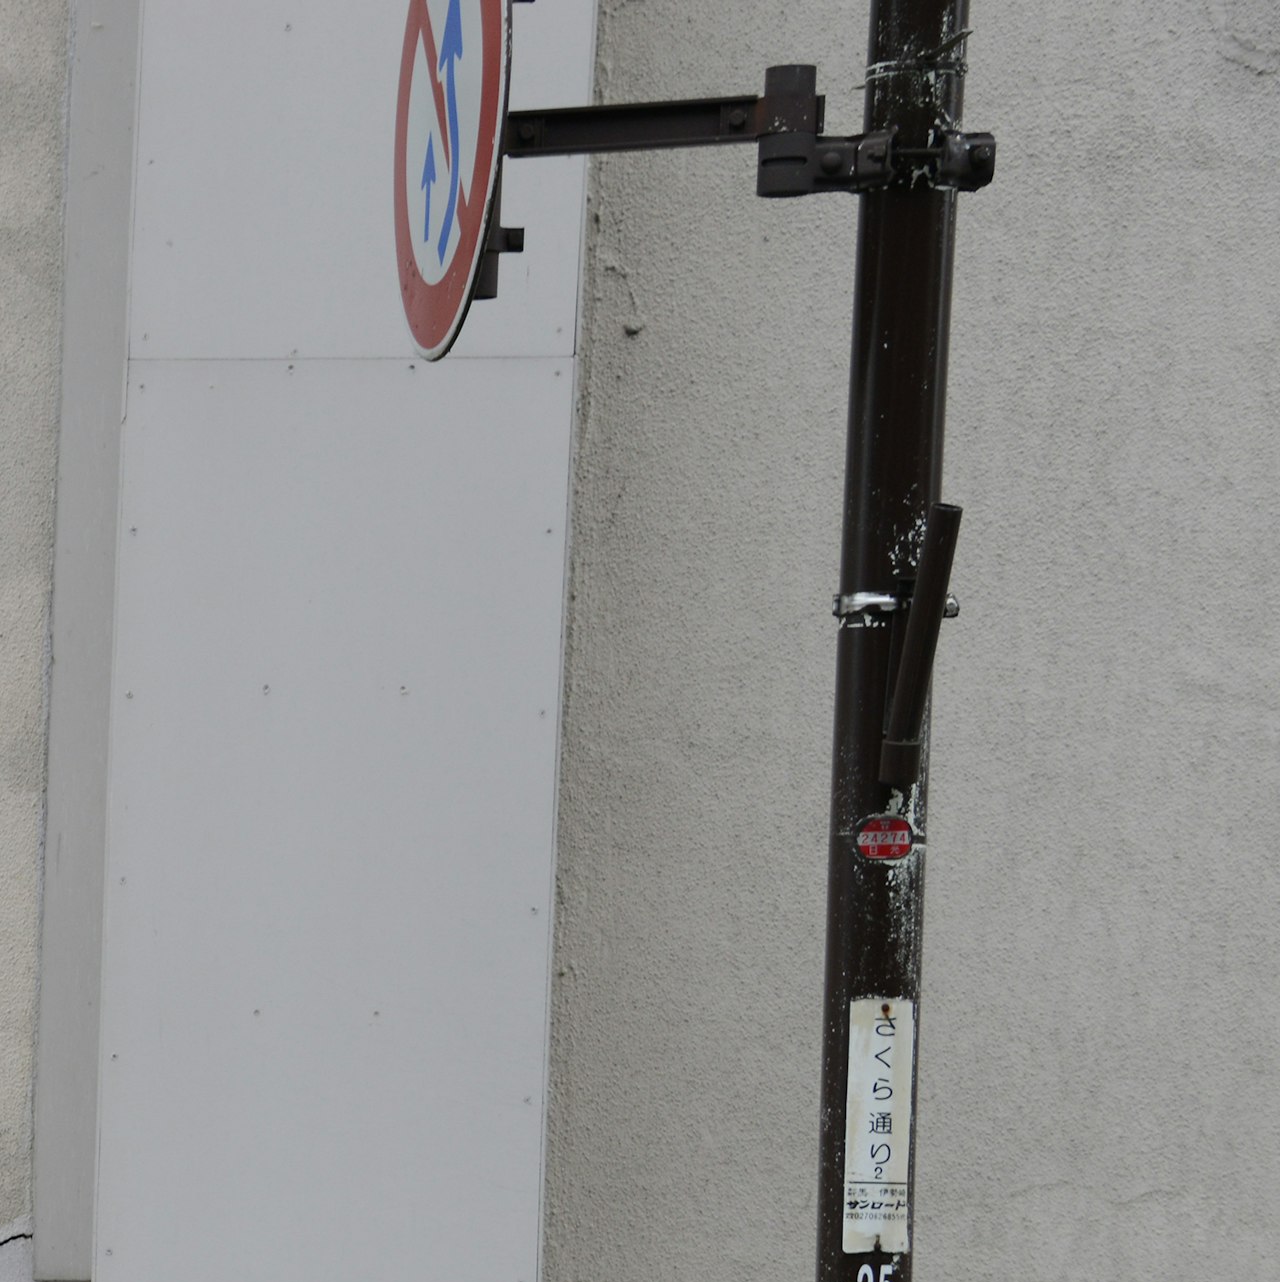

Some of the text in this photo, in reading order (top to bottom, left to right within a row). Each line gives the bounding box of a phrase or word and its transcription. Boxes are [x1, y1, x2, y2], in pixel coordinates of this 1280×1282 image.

[862, 833, 906, 844] 24274
[868, 1012, 897, 1165] さくら通り
[874, 1166, 883, 1180] 2
[847, 1199, 906, 1211] サンロード
